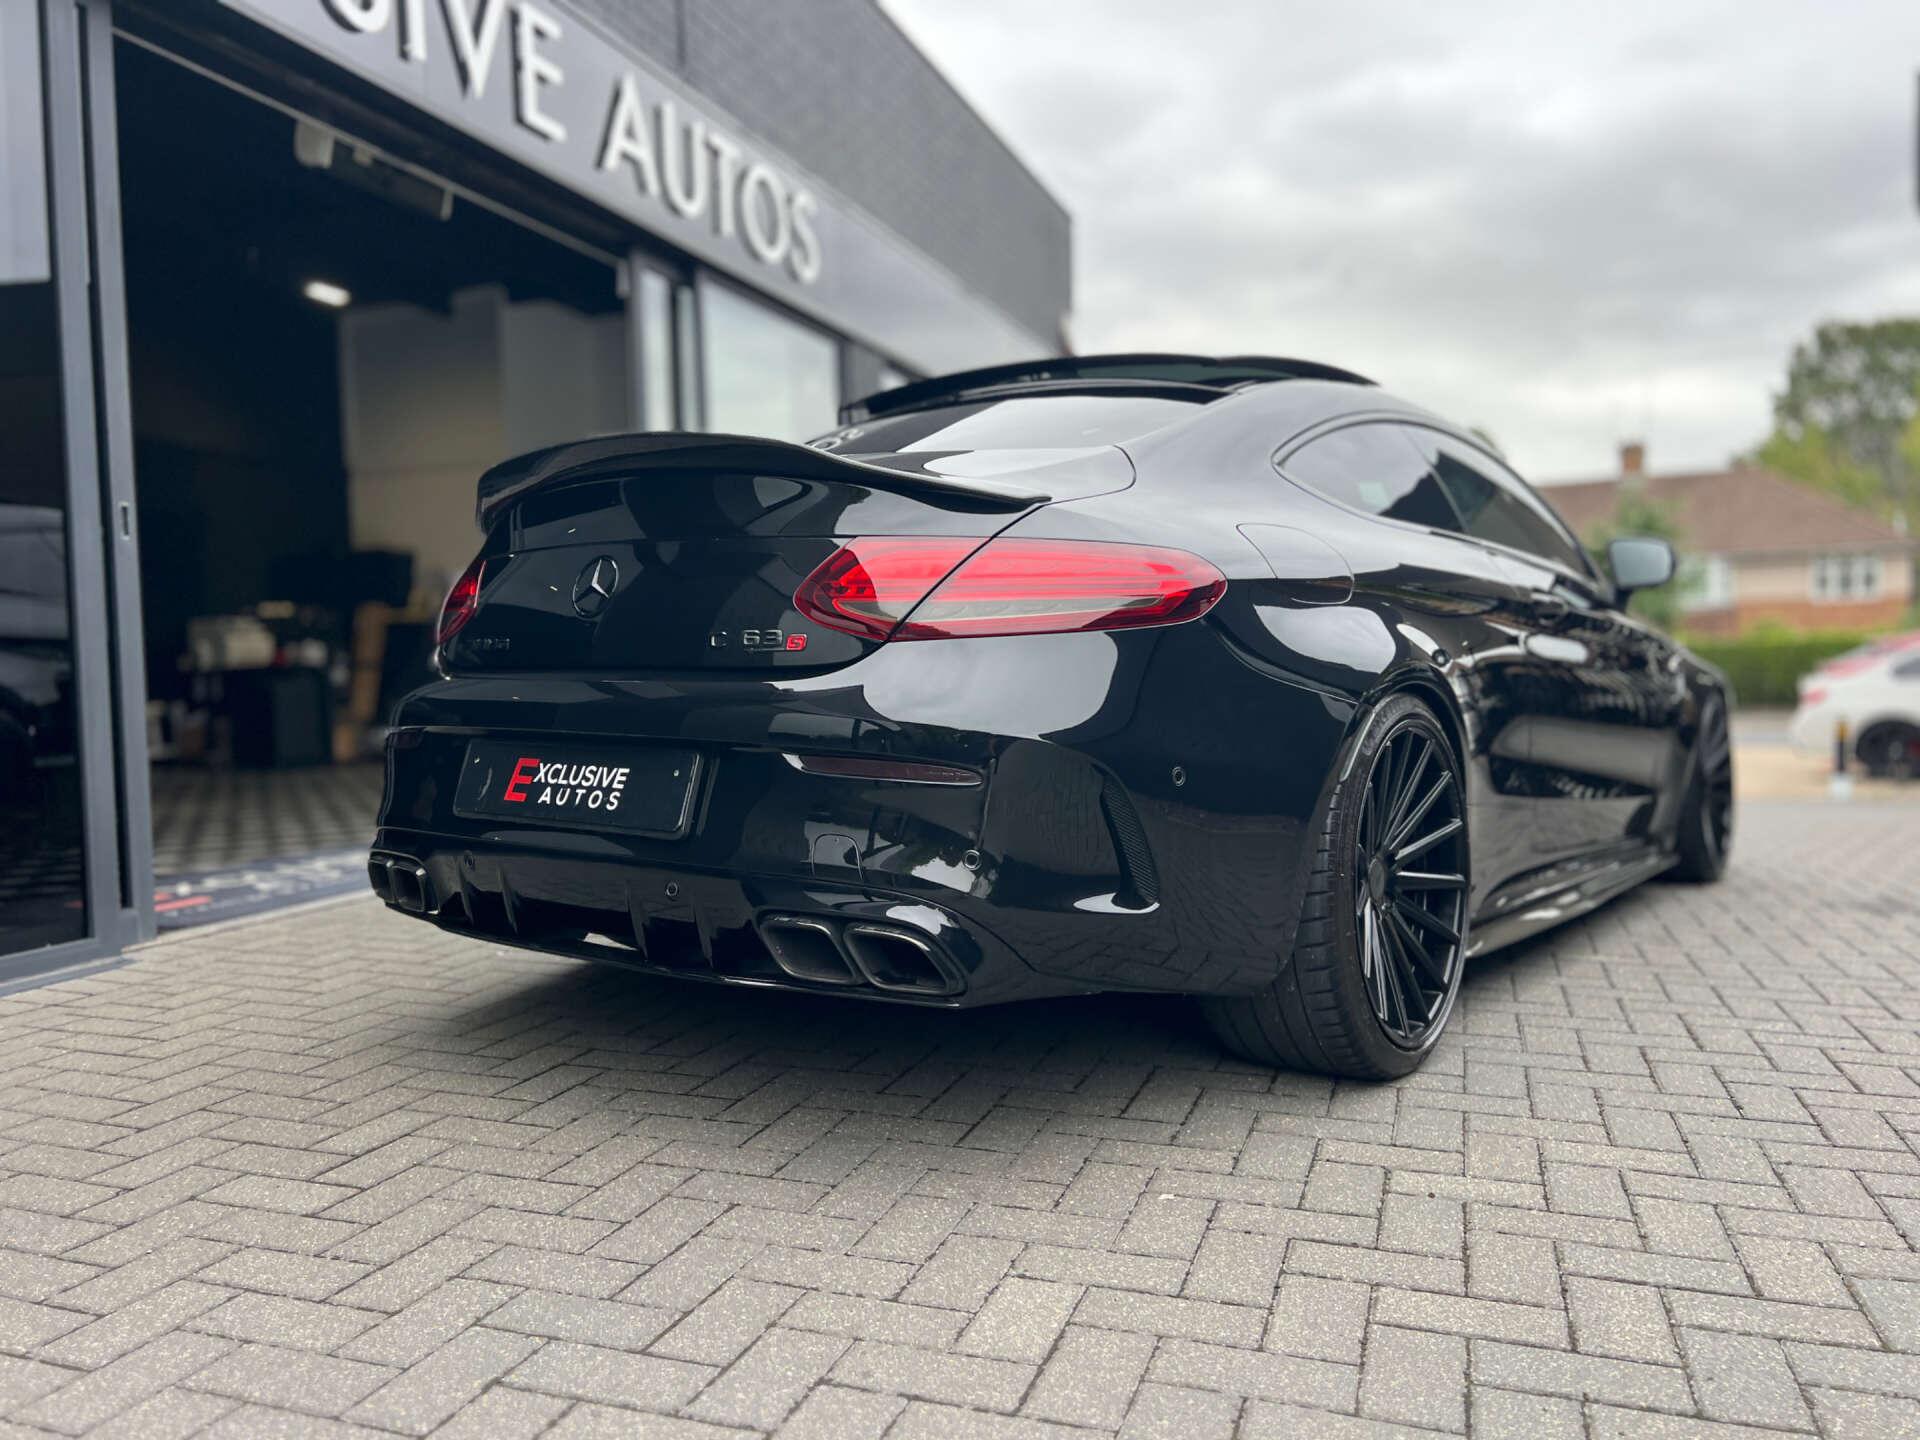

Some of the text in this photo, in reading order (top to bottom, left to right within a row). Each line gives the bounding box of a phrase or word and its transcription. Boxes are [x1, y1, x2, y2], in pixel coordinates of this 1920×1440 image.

[600, 74, 821, 284] AUTOS
[503, 757, 630, 802] EXCLUSIVE
[537, 786, 621, 811] AUTOS
